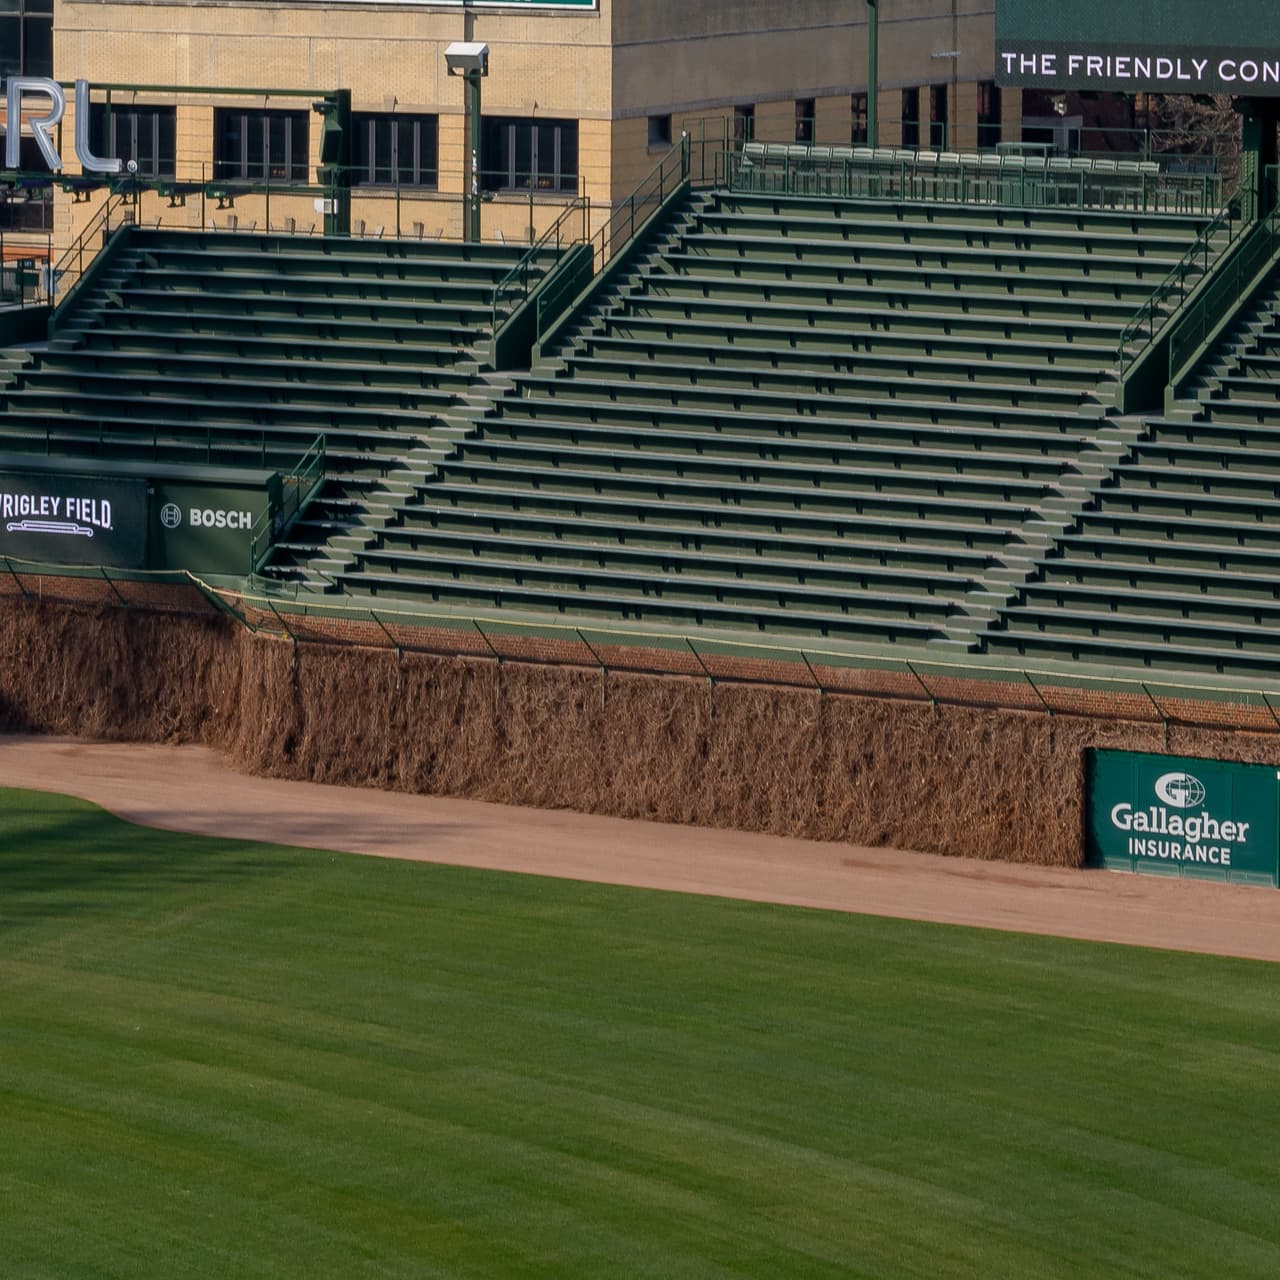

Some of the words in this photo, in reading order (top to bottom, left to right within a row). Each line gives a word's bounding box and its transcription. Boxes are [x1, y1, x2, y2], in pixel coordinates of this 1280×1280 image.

[1001, 52, 1057, 77] THE
[1068, 55, 1208, 81] FRIENDLY
[190, 508, 252, 529] BOSCH
[1111, 802, 1250, 843] Gallagher
[1128, 836, 1231, 866] INSURANCE
